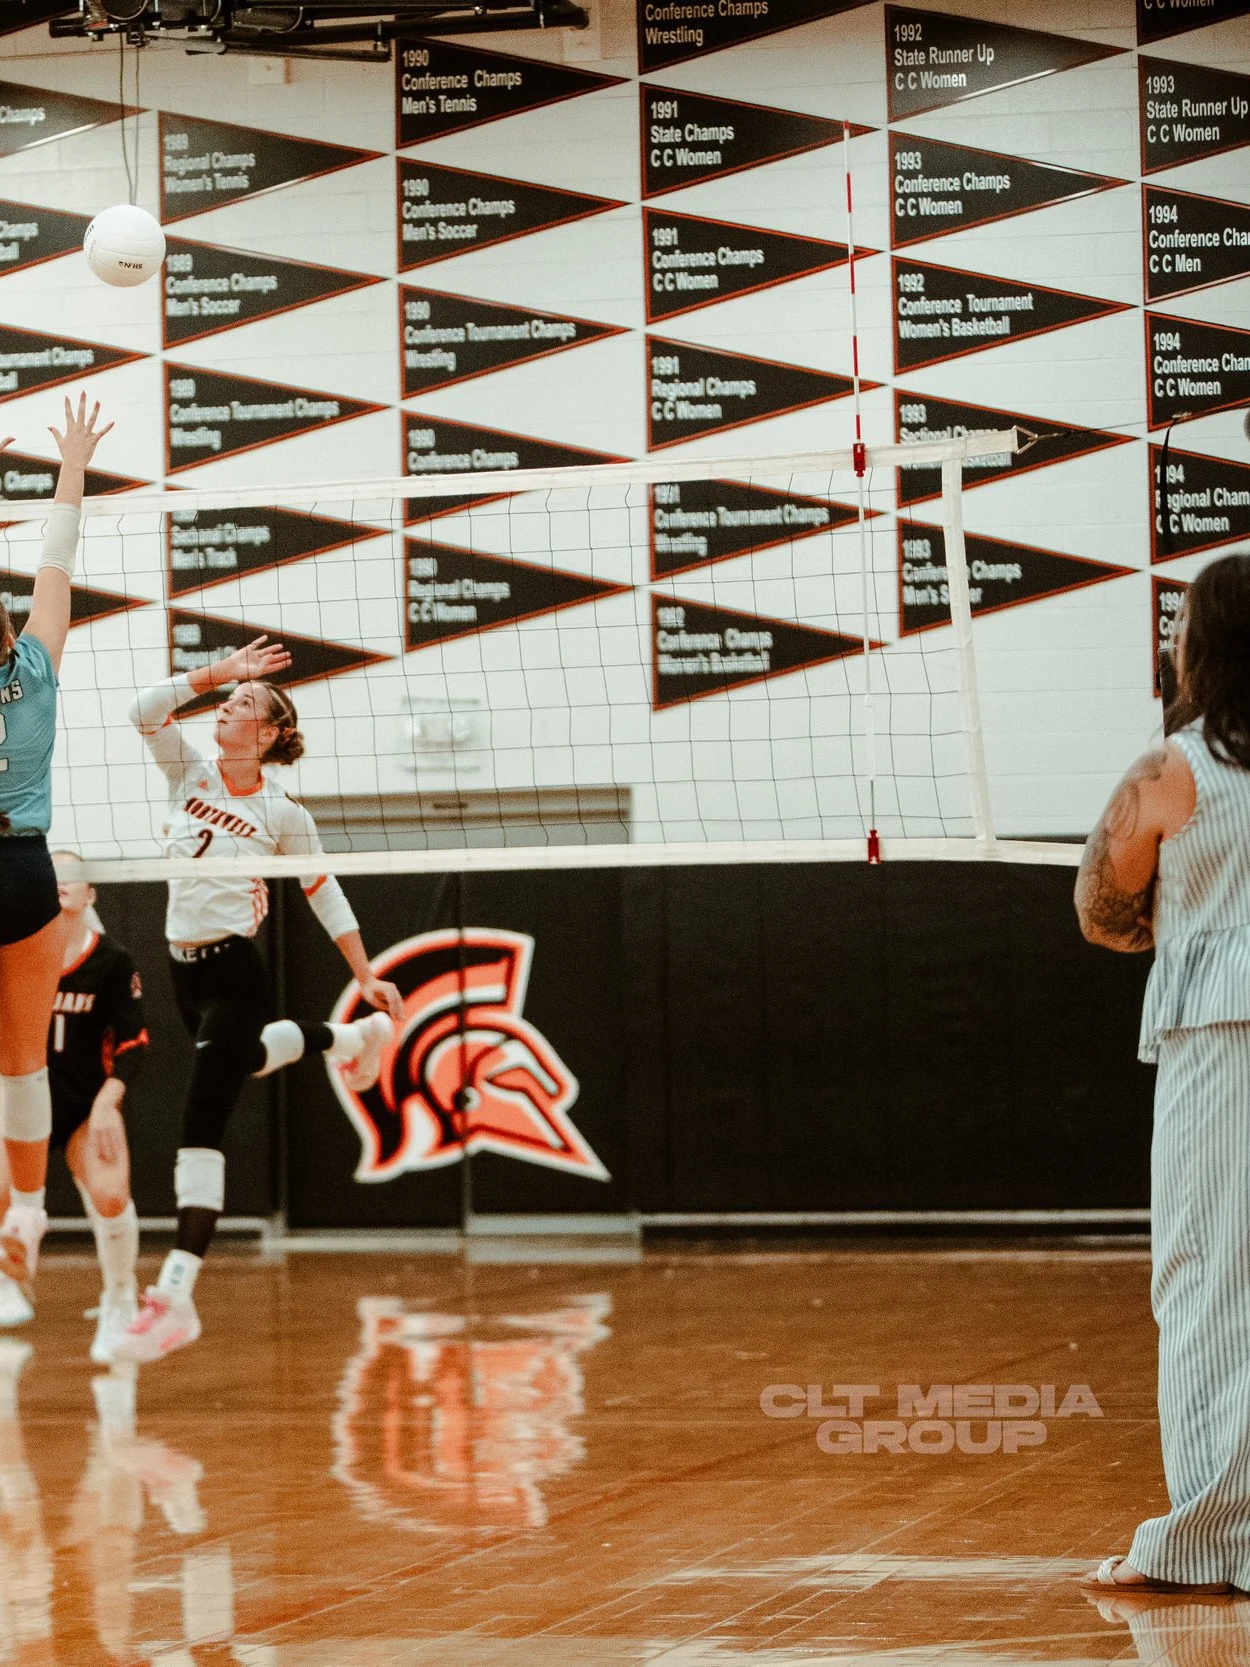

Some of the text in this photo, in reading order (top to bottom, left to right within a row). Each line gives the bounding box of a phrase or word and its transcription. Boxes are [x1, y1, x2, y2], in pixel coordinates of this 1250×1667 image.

[645, 0, 769, 21] Conference Champs
[645, 25, 703, 47] Wrestling
[894, 23, 923, 41] 1992
[402, 49, 430, 67] 1990
[894, 44, 995, 67] State Runner Up
[401, 69, 523, 91] Conference Champs
[895, 71, 967, 90] C C Women
[1146, 75, 1175, 94] 1993
[401, 94, 478, 115] Men's Tennis
[650, 100, 679, 119] 1991
[1146, 96, 1248, 119] State Runner Up
[650, 123, 735, 144] State Champs
[1147, 123, 1220, 143] C C Women
[165, 152, 256, 176] Regional Champs
[650, 148, 722, 168] C C Women
[894, 152, 922, 170] 1993
[165, 172, 250, 193] Women's Tennis
[895, 172, 1011, 194] Conference Champs
[402, 197, 516, 219] Conference Champs
[895, 197, 963, 217] C C Women
[1149, 205, 1178, 224] 1994
[402, 221, 478, 241] Men's Soccer
[652, 227, 679, 246] 1991
[1149, 229, 1220, 248] Conference
[652, 246, 765, 269] Conference Champs
[1150, 253, 1202, 273] C C Men
[167, 272, 278, 295] Conference Champs
[652, 271, 719, 292] C C Women
[898, 273, 925, 292] 1992
[167, 296, 241, 317] Men's Soccer
[898, 293, 1034, 316] Conference Tournament
[404, 319, 577, 345] Conference Tournament Champs
[898, 316, 1010, 339] Women's Basketball
[1154, 332, 1181, 351] 1994
[405, 348, 457, 371] Wrestling
[1154, 355, 1219, 374] Conference
[651, 376, 757, 401] Regional Champs
[1154, 378, 1222, 398] C C Women
[170, 398, 340, 424] Conference Tournament Champs
[651, 400, 722, 421] C C Women
[899, 404, 927, 423] 1993
[408, 448, 520, 472] Conference Champs
[1169, 514, 1179, 534] C
[1181, 513, 1230, 532] Women
